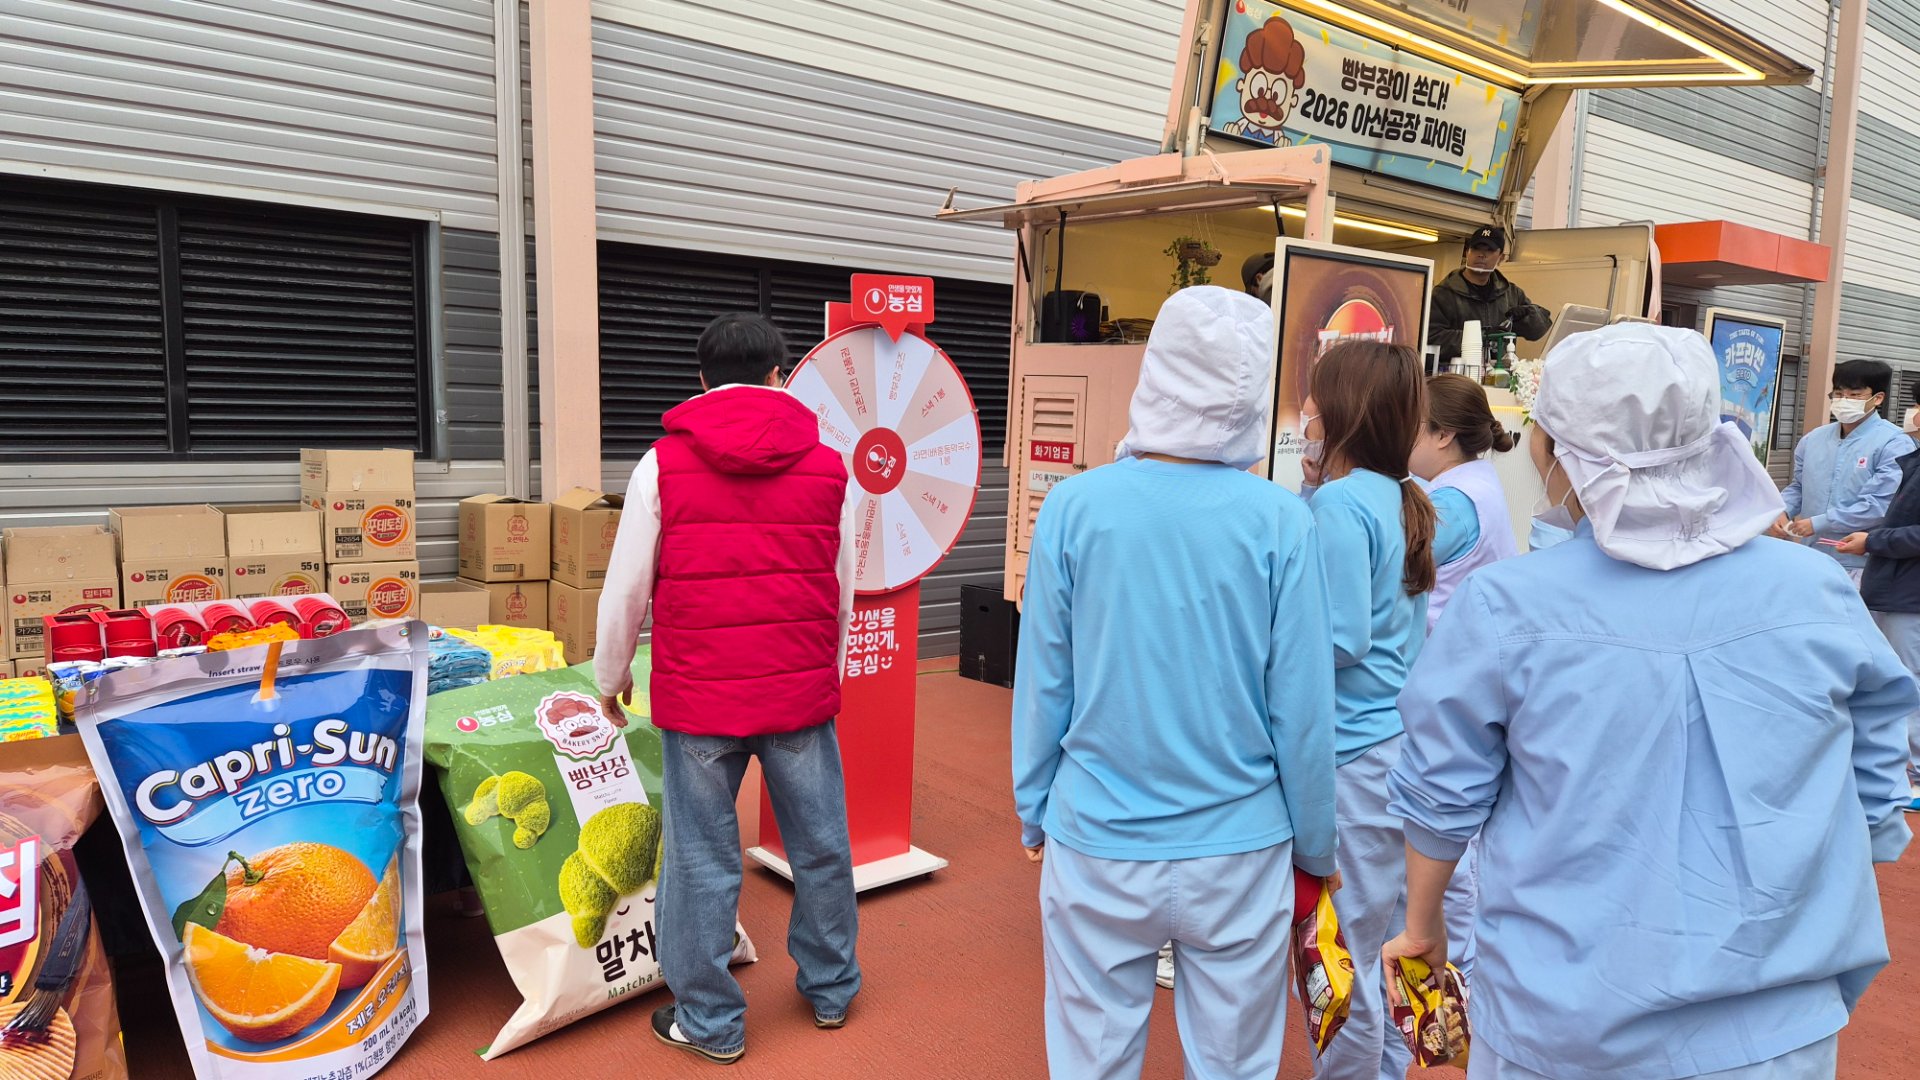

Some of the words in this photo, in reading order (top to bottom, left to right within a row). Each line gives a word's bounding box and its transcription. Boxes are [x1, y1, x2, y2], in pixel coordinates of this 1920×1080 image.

[1341, 57, 1410, 104] 빵부장이
[1412, 74, 1450, 111] 쏜다!
[1300, 88, 1350, 129] 2026
[1351, 103, 1421, 144] 아산공장
[1421, 116, 1467, 157] 파이팅
[888, 294, 922, 313] 농심
[1725, 342, 1765, 373] 카프리썬
[1034, 445, 1070, 459] 화기엄금
[1032, 473, 1043, 481] LPG
[346, 502, 365, 510] 농심
[406, 500, 412, 508] g
[365, 515, 406, 535] 포테토칩
[145, 571, 168, 581] 농심
[204, 567, 216, 576] 50
[217, 569, 224, 577] g
[247, 567, 266, 575] 농심
[300, 562, 313, 571] 55
[314, 563, 320, 572] g
[400, 570, 409, 578] 50
[410, 571, 416, 579] g
[351, 576, 369, 584] 농심
[28, 594, 51, 603] 농심
[372, 587, 408, 608] 포테토칩
[849, 607, 896, 632] 인생을
[847, 629, 900, 655] 맛있게,
[305, 655, 321, 665] 사용
[846, 653, 878, 678] 농심
[208, 667, 235, 678] Insert
[238, 665, 261, 674] straw
[477, 709, 515, 727] 농심
[562, 738, 590, 747] BAKERY
[591, 726, 610, 743] SNACK
[135, 719, 398, 824] Capri-Sun
[567, 755, 630, 790] 빵부장
[232, 769, 345, 821] zero
[608, 973, 653, 999] Matcha
[345, 1001, 375, 1035] 제로
[377, 959, 408, 1009] 오렌지
[363, 1034, 378, 1052] 200
[379, 1024, 391, 1038] mL
[399, 997, 416, 1021] kcal)
